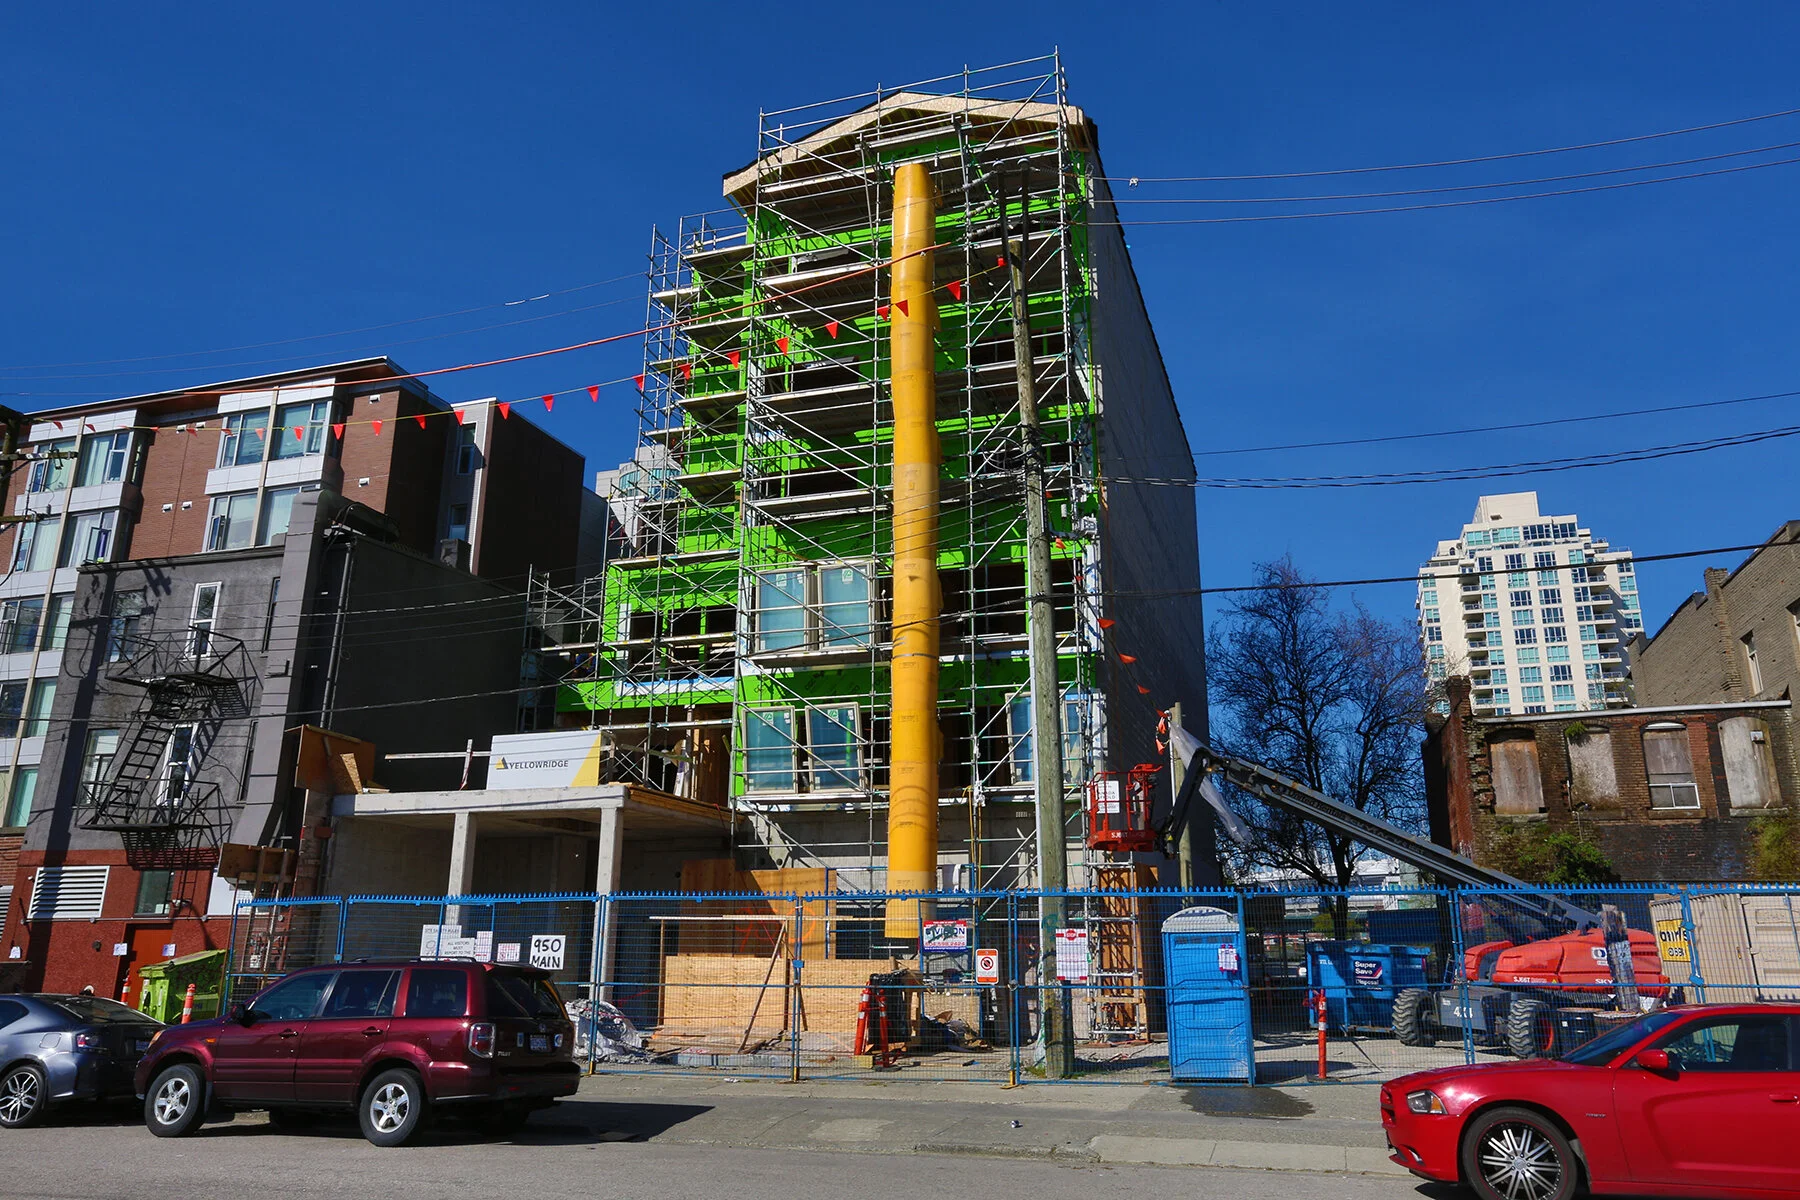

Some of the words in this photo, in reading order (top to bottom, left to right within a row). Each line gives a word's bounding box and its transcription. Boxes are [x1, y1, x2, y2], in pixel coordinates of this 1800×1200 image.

[509, 760, 568, 769] YELLOWRIDGE
[533, 938, 562, 953] 950
[531, 955, 561, 969] MAIN
[1354, 960, 1377, 969] Super
[1354, 967, 1373, 975] Save
[1355, 978, 1380, 986] Disposal
